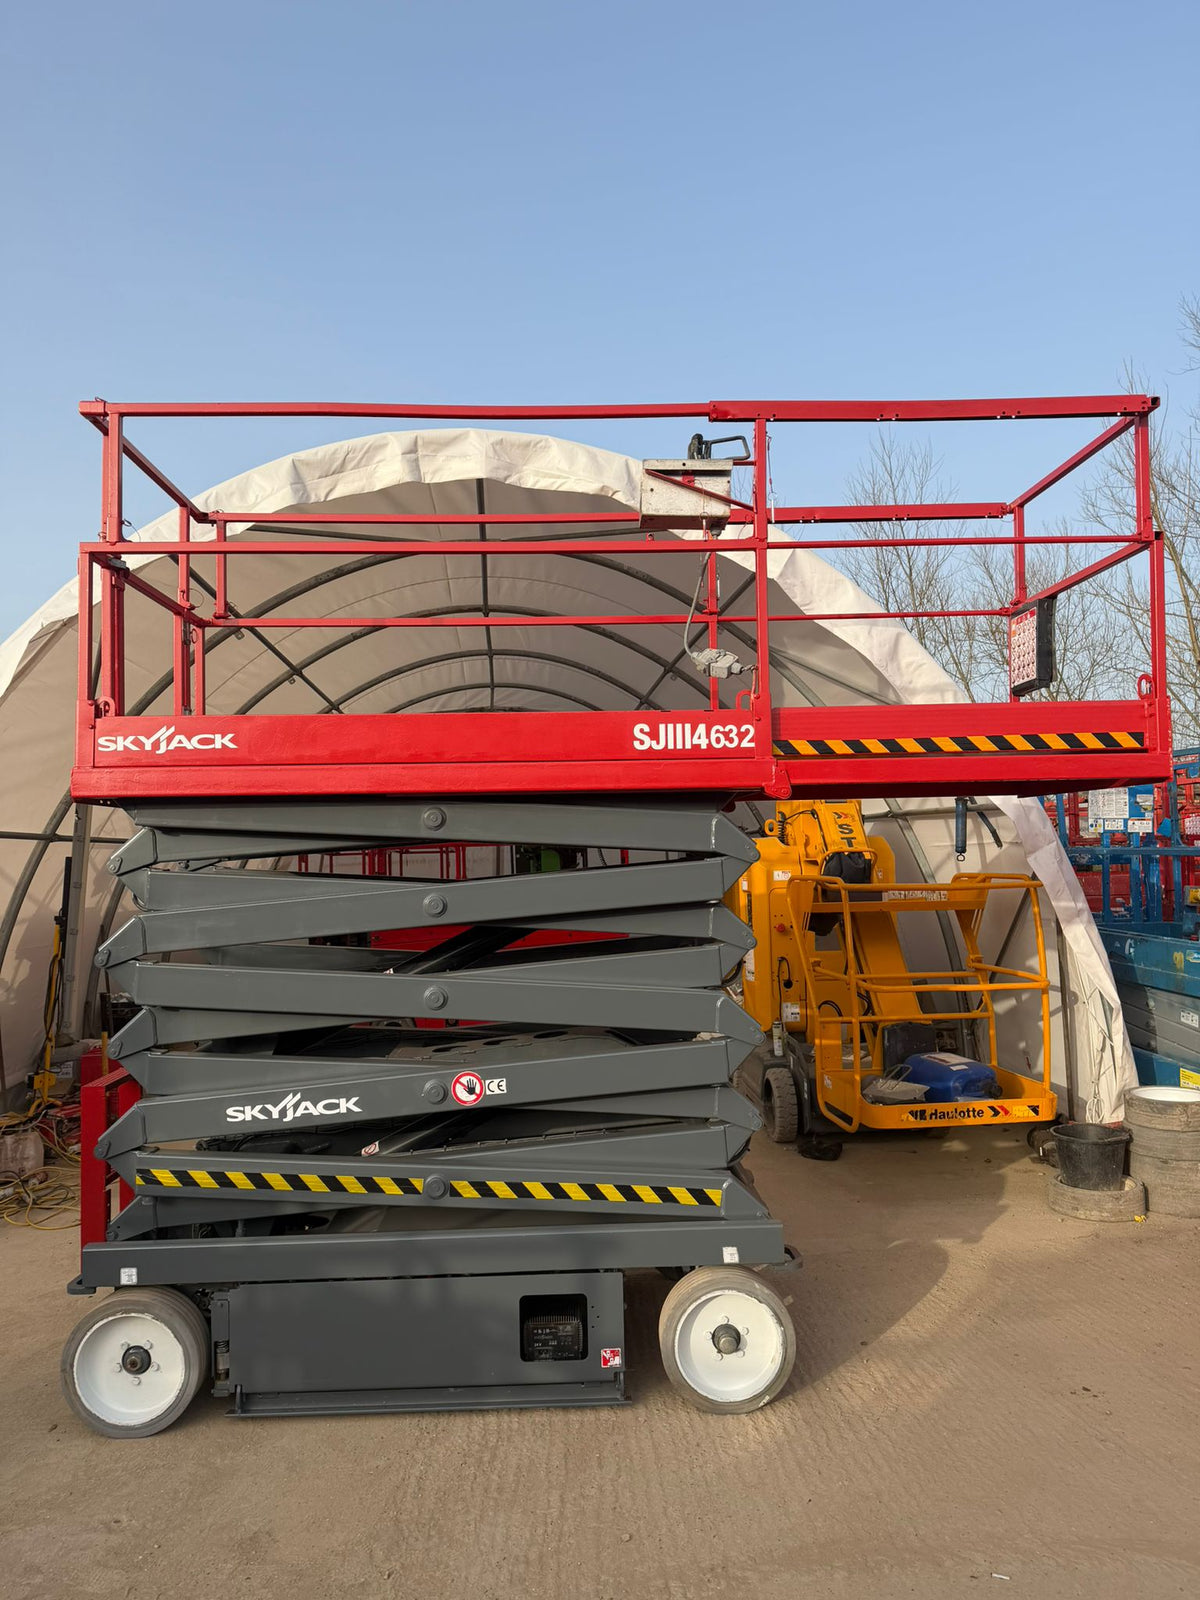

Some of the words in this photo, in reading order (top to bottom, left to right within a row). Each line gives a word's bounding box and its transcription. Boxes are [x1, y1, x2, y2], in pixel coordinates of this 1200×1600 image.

[97, 725, 239, 754] SKYJACK
[487, 1080, 505, 1093] CE
[225, 1092, 363, 1122] SKYJACK
